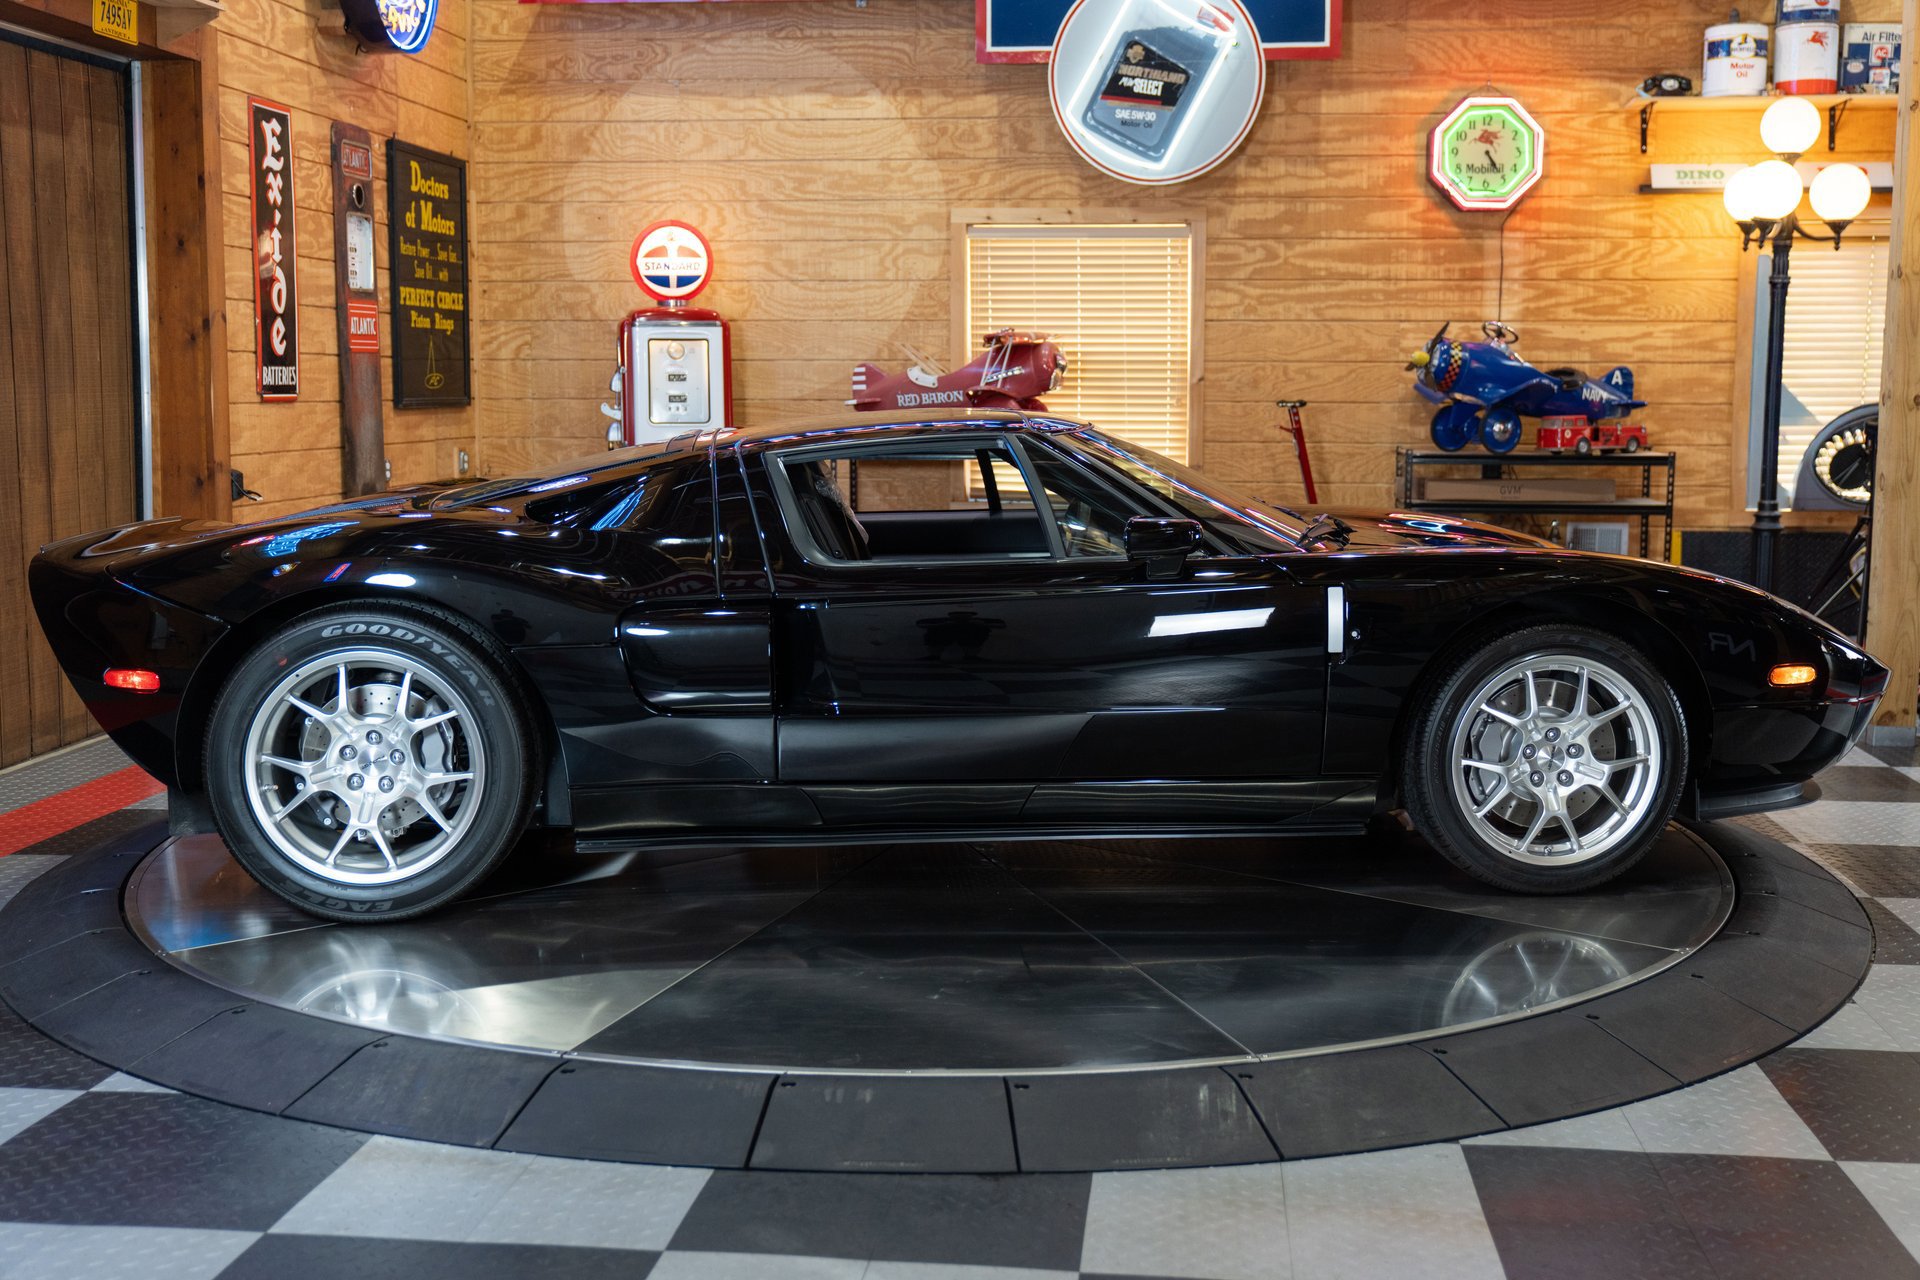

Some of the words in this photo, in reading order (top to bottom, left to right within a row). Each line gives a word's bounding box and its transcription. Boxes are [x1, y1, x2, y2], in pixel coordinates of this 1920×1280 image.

[101, 1, 132, 30] 7495AV
[1862, 31, 1875, 41] Air
[1876, 48, 1889, 56] AC
[1730, 62, 1755, 70] Motor
[1736, 70, 1748, 78] Oil
[1133, 77, 1164, 97] SELECT
[1115, 108, 1132, 120] SAE
[1131, 110, 1157, 121] 5W-30
[1121, 120, 1141, 128] Motor
[1469, 120, 1476, 130] 11
[1483, 115, 1493, 126] 12
[1501, 120, 1505, 129] 1
[1456, 131, 1468, 142] 10
[1512, 131, 1518, 141] 2
[1451, 147, 1459, 157] 9
[1516, 147, 1521, 158] 3
[1456, 163, 1462, 174] 8
[1511, 163, 1517, 173] 4
[410, 160, 449, 200] Doctors
[1501, 174, 1506, 185] 5
[1676, 169, 1725, 180] DINO
[1468, 176, 1473, 185] 7
[1483, 180, 1489, 189] 6
[405, 201, 416, 229] of
[420, 200, 456, 237] Motors
[414, 260, 425, 279] Save
[438, 267, 449, 283] with
[644, 262, 700, 271] STANDARD
[399, 286, 435, 308] PERFECT
[437, 291, 464, 311] CIRCLE
[350, 316, 377, 336] ATLANTIC
[410, 310, 431, 329] Piston
[434, 312, 455, 336] Rings
[262, 365, 297, 387] BATTERIES
[1611, 369, 1623, 385] A
[896, 393, 920, 407] RED
[921, 390, 964, 405] BARON
[1581, 387, 1608, 404] NAVY
[1499, 485, 1521, 495] GVM
[321, 622, 497, 707] GOODYEAR
